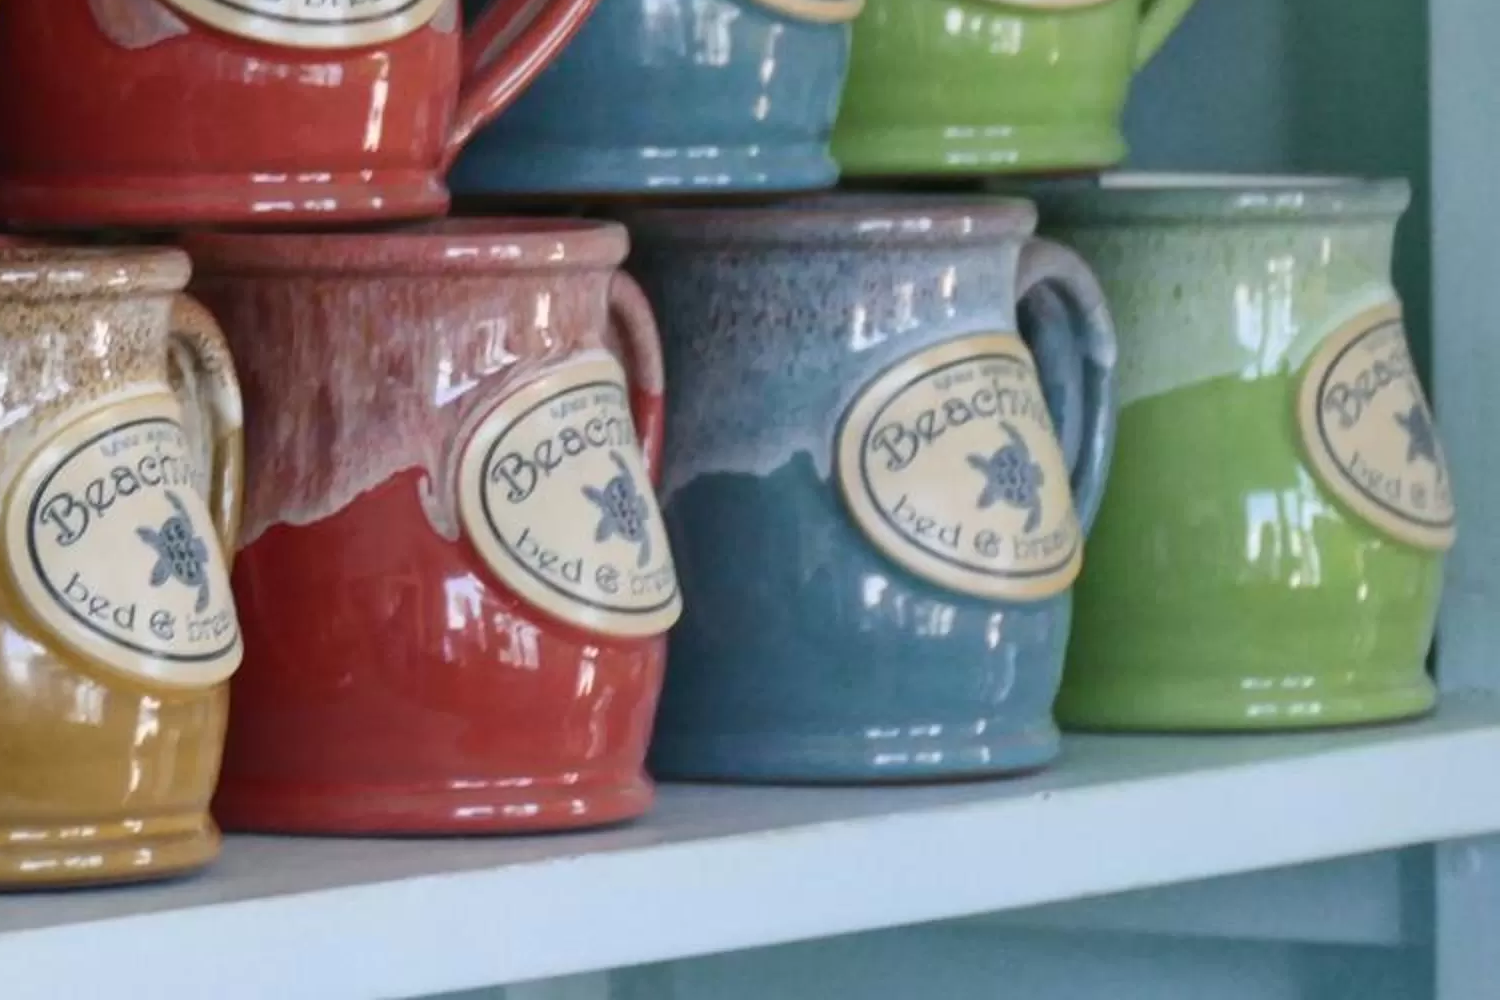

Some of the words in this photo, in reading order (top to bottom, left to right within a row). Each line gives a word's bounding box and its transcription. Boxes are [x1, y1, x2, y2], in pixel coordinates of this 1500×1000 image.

[892, 493, 962, 549] bed
[516, 527, 584, 583] bed
[63, 572, 136, 631] bed
